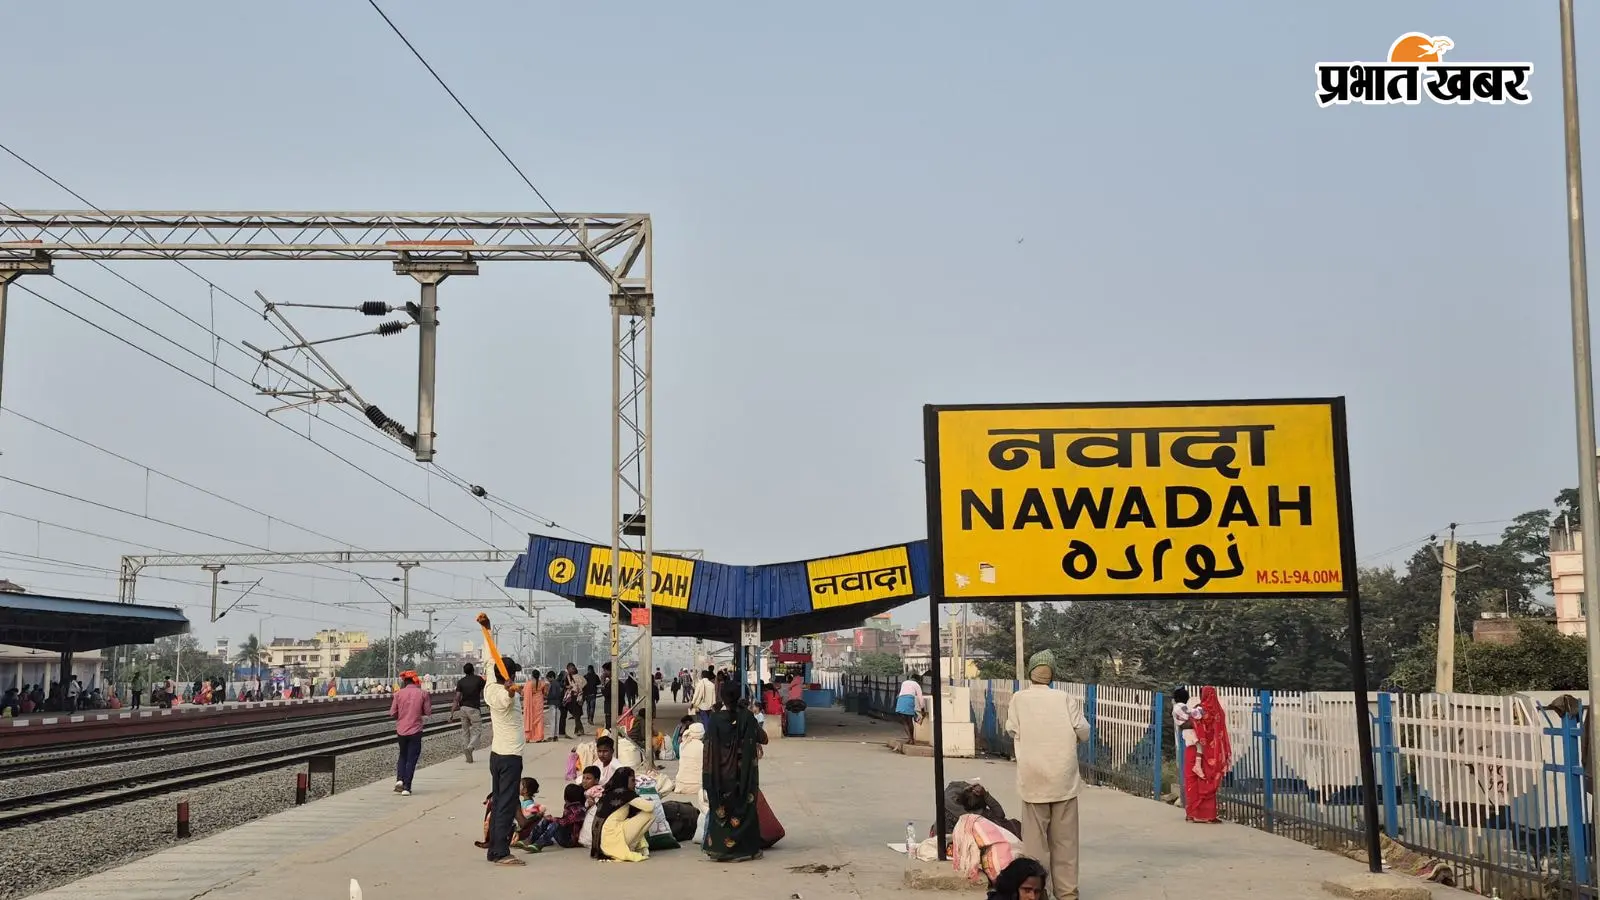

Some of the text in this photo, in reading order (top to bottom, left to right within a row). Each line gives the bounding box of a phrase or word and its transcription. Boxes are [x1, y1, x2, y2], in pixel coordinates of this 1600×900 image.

[987, 424, 1275, 478] नवादा
[961, 485, 1312, 530] NAWADAH
[555, 561, 567, 579] 2
[812, 565, 907, 595] नवादा
